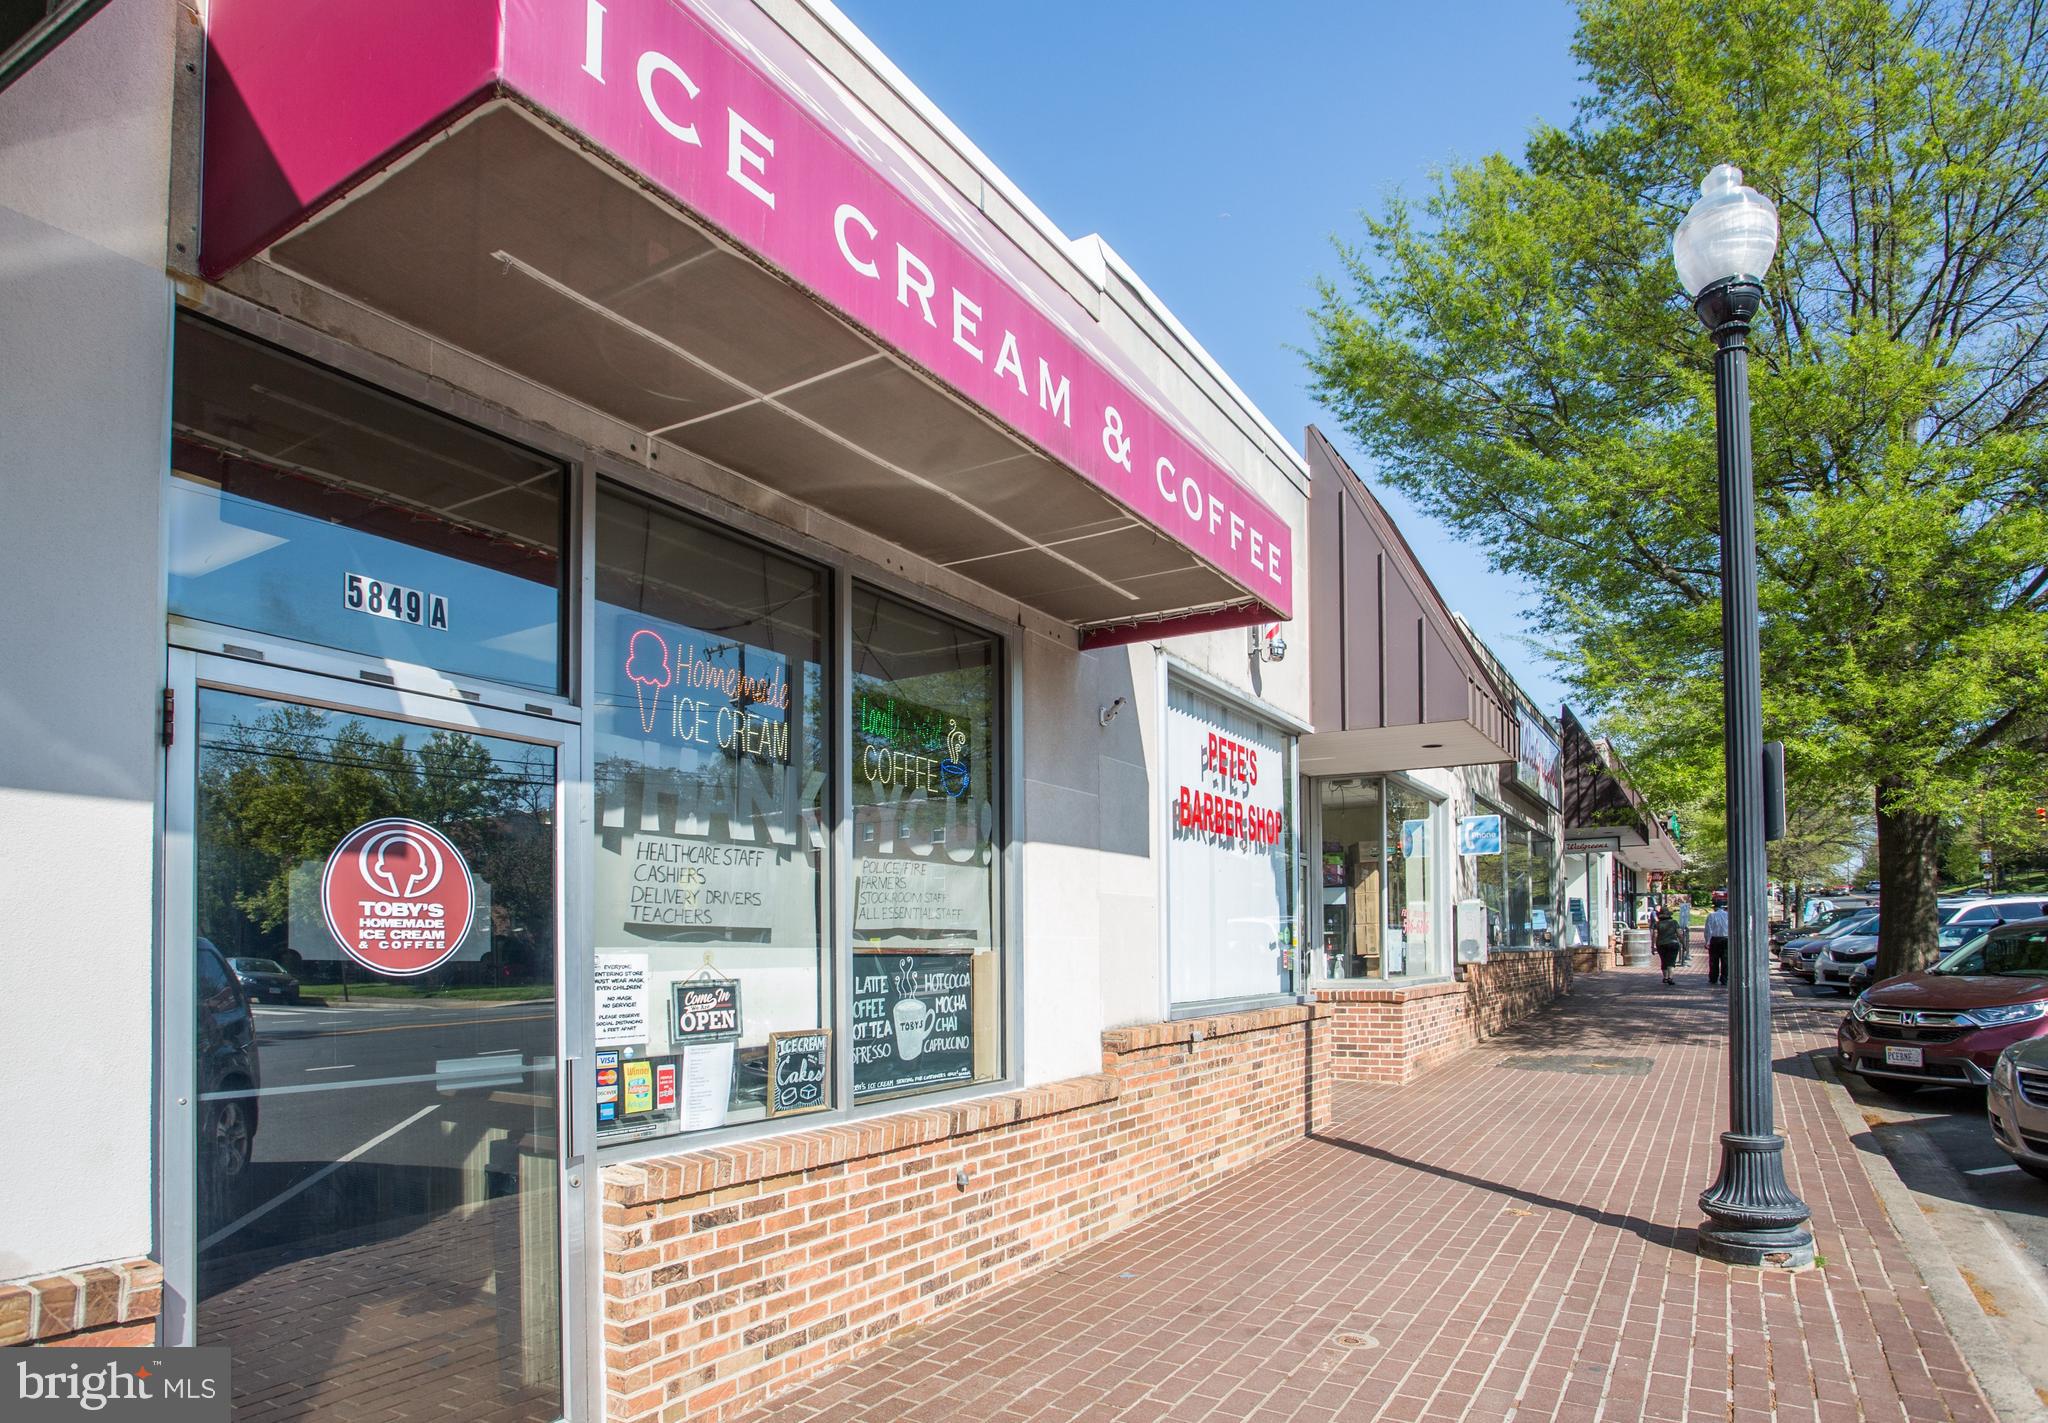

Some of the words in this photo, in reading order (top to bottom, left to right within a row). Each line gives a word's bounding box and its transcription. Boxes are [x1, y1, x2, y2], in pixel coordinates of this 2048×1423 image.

[581, 0, 775, 210] ICE
[834, 204, 1071, 428] CREAM
[1102, 406, 1132, 472] &
[1156, 457, 1282, 584] COFFEE
[348, 575, 420, 622] 5849
[432, 598, 446, 629] A
[676, 644, 789, 709] Homemade
[672, 695, 709, 743] ICE
[717, 707, 788, 760] CREAM
[864, 745, 938, 793] COFFEE
[1208, 732, 1257, 786] PETE'S
[1181, 785, 1243, 840] BARBER
[1248, 805, 1282, 846] SHOP
[636, 841, 720, 865] HEALTHCARE
[723, 848, 764, 867] STAFF
[634, 864, 706, 884] CASHIERS
[861, 876, 907, 889] FARMERS
[631, 885, 699, 905] DELIVERY
[706, 889, 761, 906] DRIVERS
[358, 901, 445, 918] TOBY'S
[631, 905, 712, 924] TEACHERS
[858, 907, 881, 920] ALL
[882, 907, 936, 920] ESSENTIAL
[936, 907, 963, 921] STAFF
[359, 918, 445, 928] HOMEMADE
[359, 930, 386, 939] ICE
[390, 930, 445, 939] CREAM
[358, 941, 369, 949] &
[378, 941, 445, 949] COFFEE
[855, 975, 889, 994] LATTE
[925, 973, 944, 992] HOT
[944, 973, 970, 990] COCOA
[685, 991, 716, 1006] Come
[715, 988, 730, 1002] In
[936, 994, 967, 1014] MOCHA
[853, 998, 886, 1018] OFFEE
[680, 1010, 735, 1031] OPEN
[853, 1022, 867, 1040] OT
[869, 1020, 893, 1039] TEA
[935, 1016, 958, 1032] CHAI
[778, 1037, 798, 1056] ICE
[798, 1036, 825, 1053] CREAM
[851, 1043, 891, 1064] SPRESSO
[924, 1036, 969, 1053] CAPPUCCINO
[600, 1056, 615, 1064] VISA
[778, 1055, 825, 1086] Cakes
